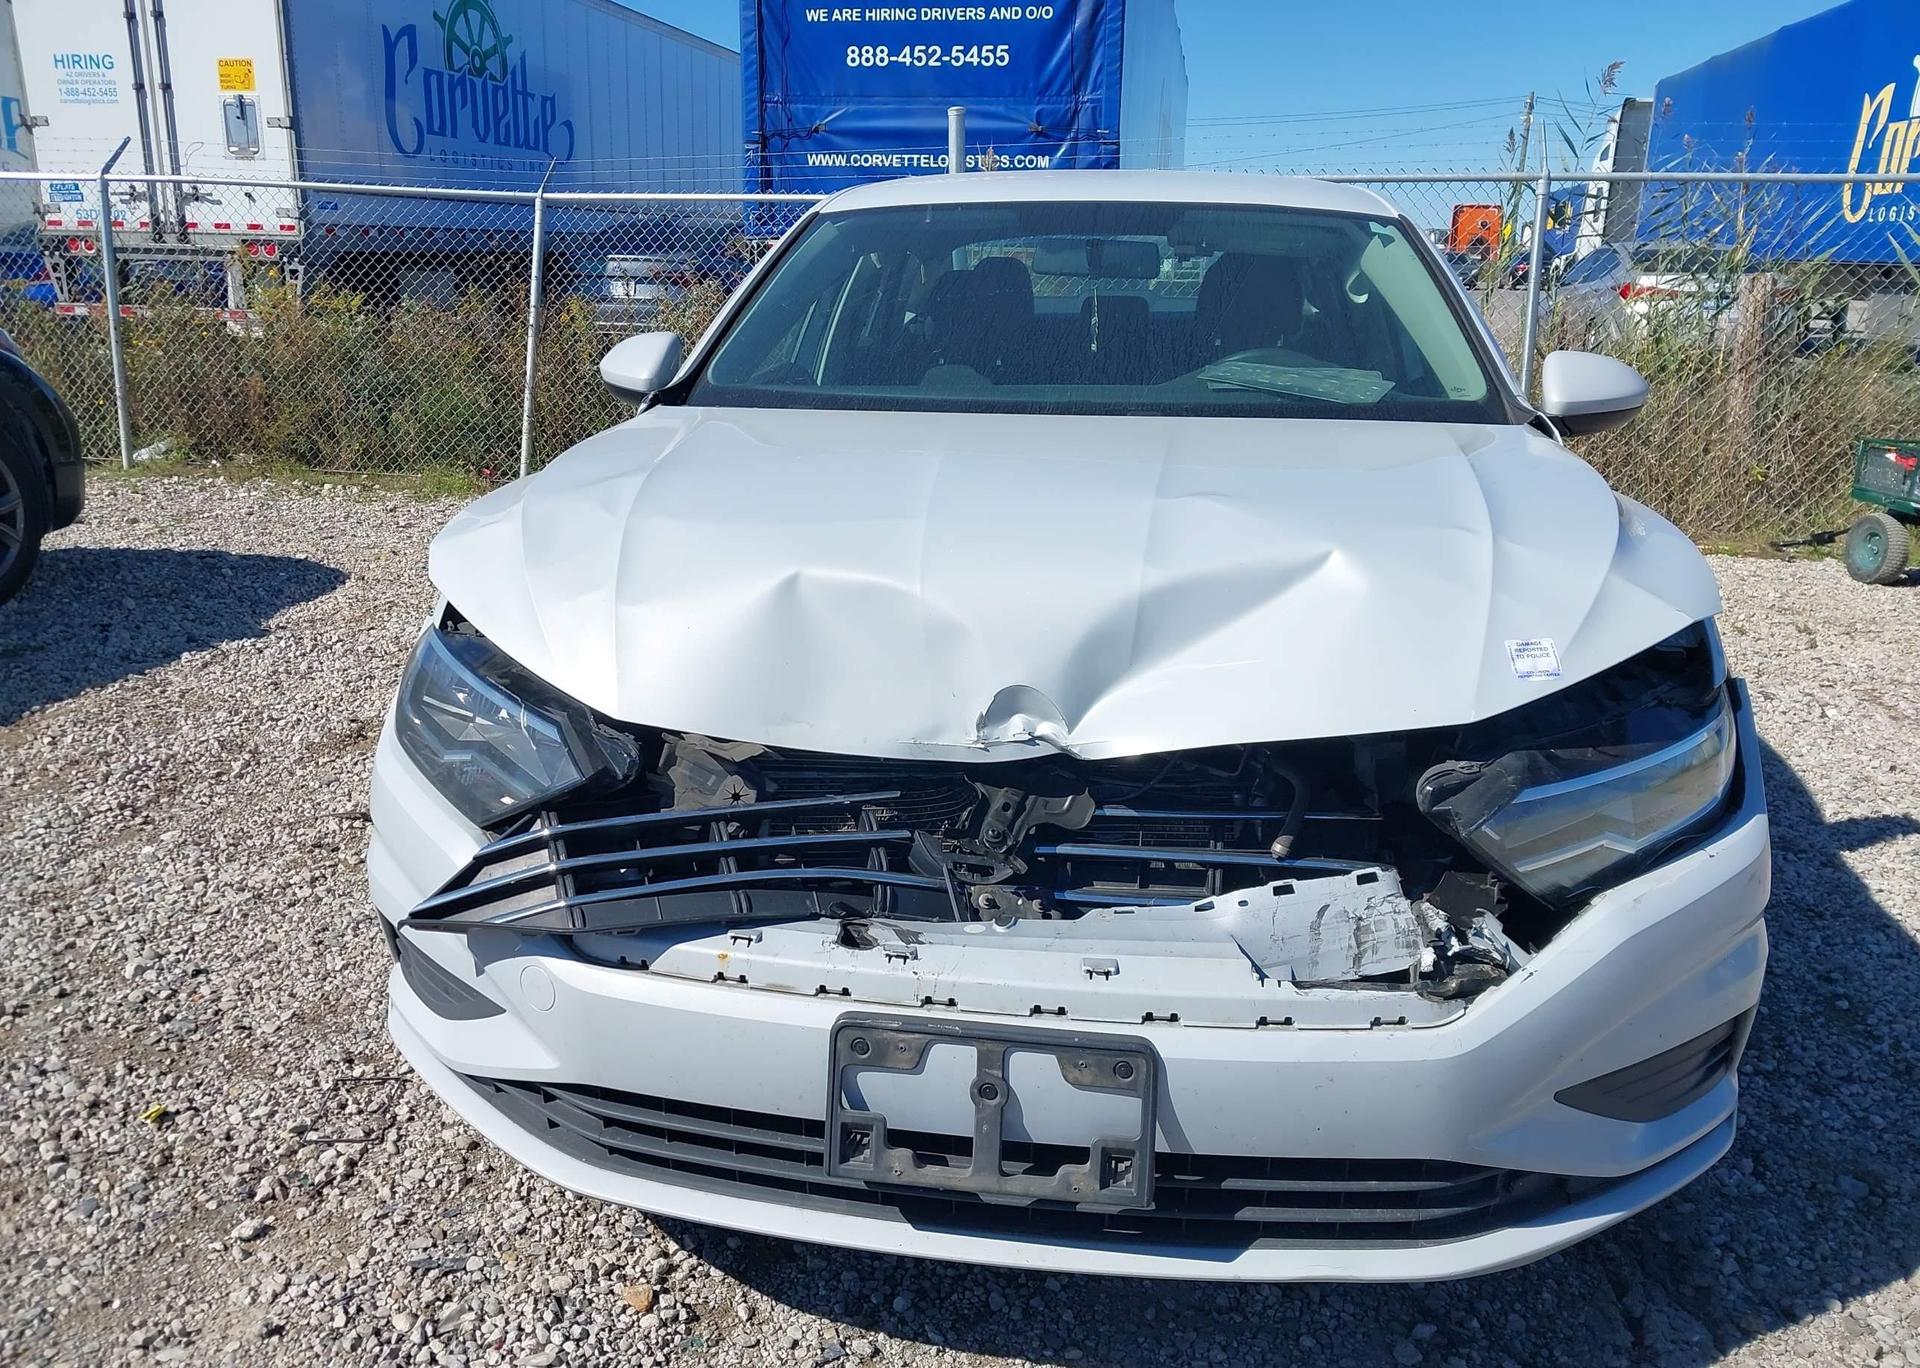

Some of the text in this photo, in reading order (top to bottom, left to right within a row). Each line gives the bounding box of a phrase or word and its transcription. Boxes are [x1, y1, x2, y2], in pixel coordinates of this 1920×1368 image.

[806, 6, 1054, 22] WE ARE HIRING DRIVERS AND O/O
[53, 53, 115, 70] HIRING
[846, 45, 1010, 67] 888-452-5455
[58, 87, 118, 97] 1-888-452-5455
[381, 23, 575, 164] Corvette
[428, 147, 513, 170] LOGISTICS
[1867, 205, 1916, 223] LOGIS
